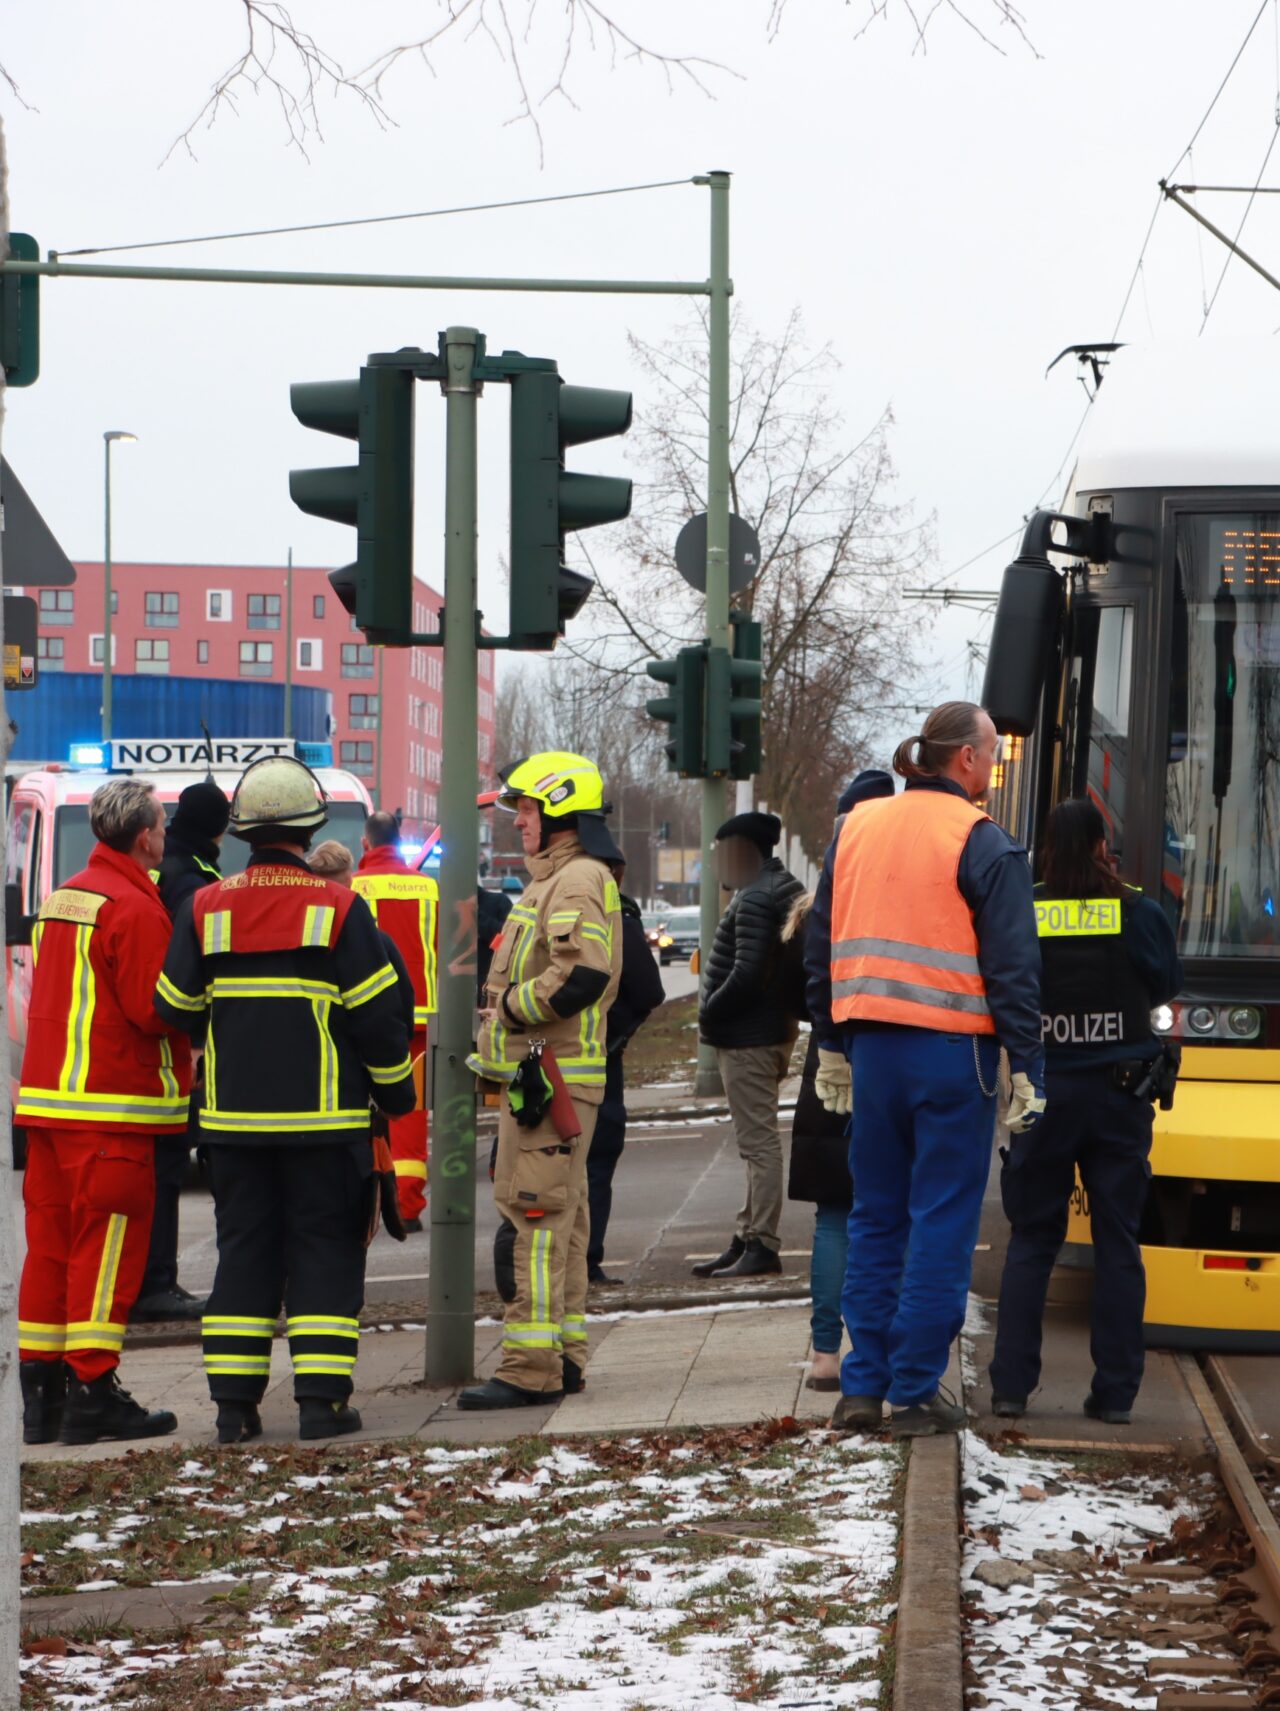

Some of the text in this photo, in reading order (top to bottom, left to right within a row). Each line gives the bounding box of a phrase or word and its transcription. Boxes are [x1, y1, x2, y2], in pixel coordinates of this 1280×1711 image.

[118, 744, 288, 764] NOTARZT
[250, 876, 327, 888] FEUERWEHR
[388, 882, 428, 892] Notarzt
[1036, 904, 1116, 930] POLIZEI
[1040, 1012, 1123, 1043] POLIZEI
